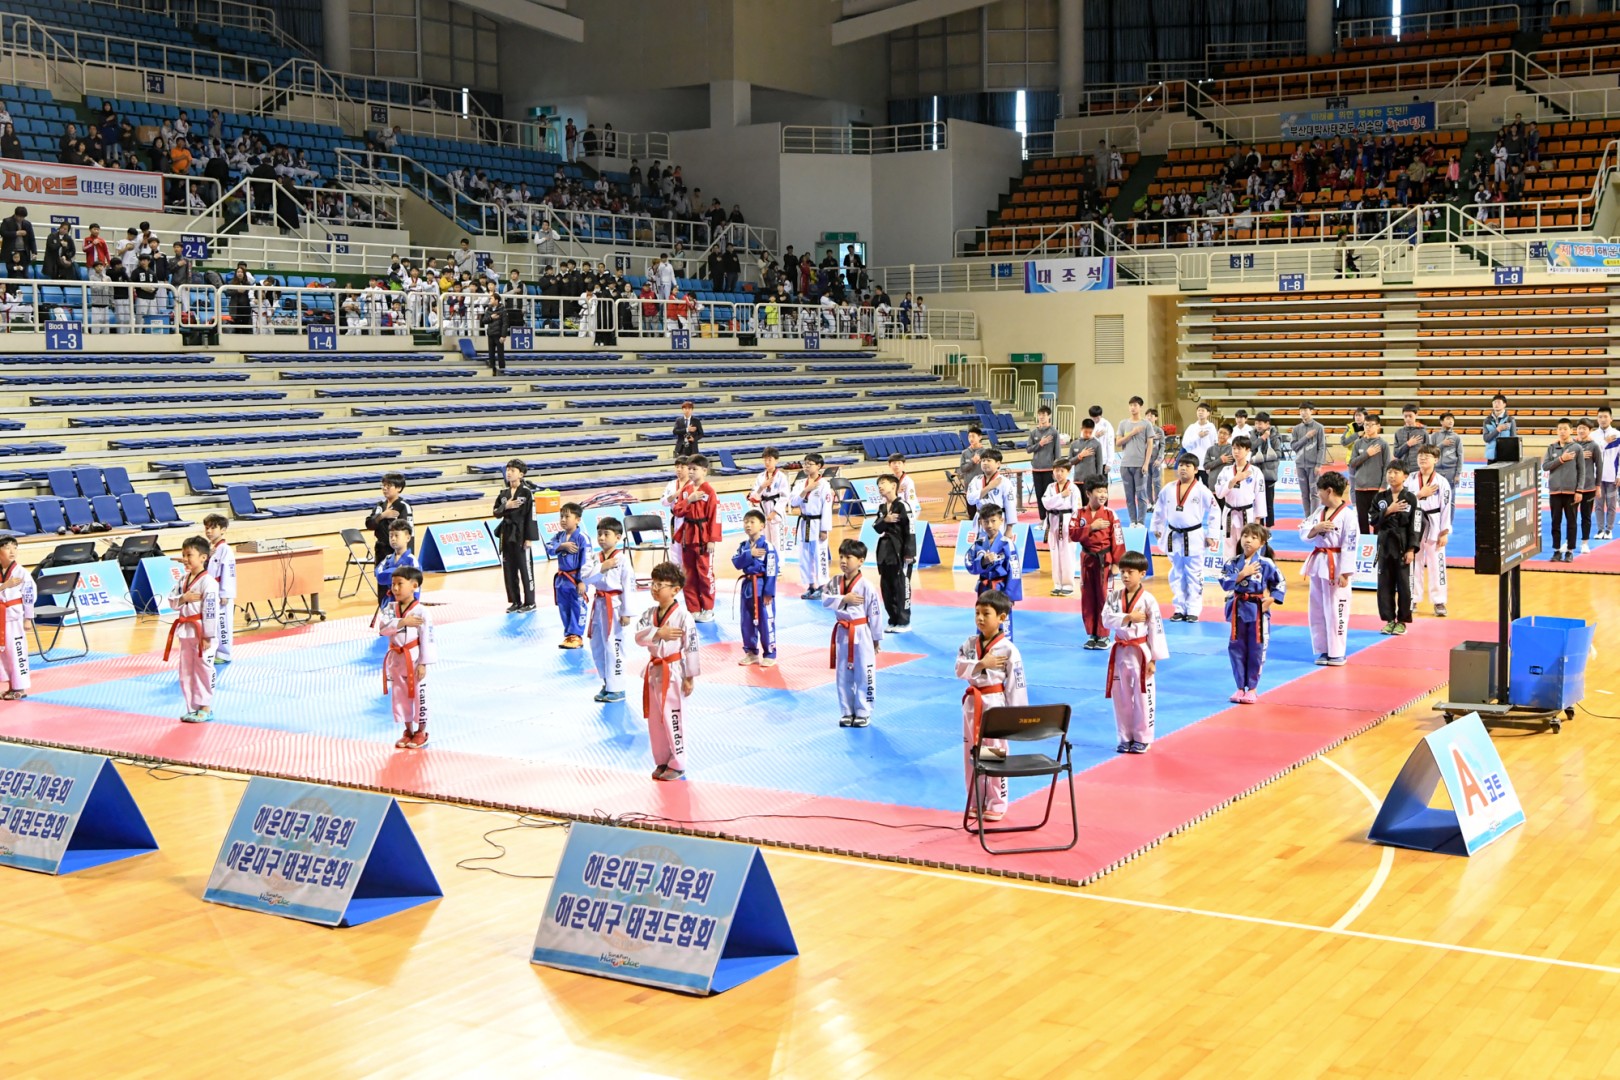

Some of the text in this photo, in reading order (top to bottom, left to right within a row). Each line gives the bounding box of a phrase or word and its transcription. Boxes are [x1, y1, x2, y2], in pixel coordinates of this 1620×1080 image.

[2, 169, 157, 199] 자이언트 대표팀 화이팅!!
[185, 244, 204, 257] 2-4
[1233, 258, 1250, 268] 3-9
[1499, 273, 1518, 283] 1-9
[1283, 281, 1300, 290] 1-8
[52, 333, 77, 349] 1-3
[313, 336, 333, 349] 1-4
[515, 336, 530, 349] 1-5
[674, 338, 688, 349] 1-6
[806, 338, 818, 349] 1-7
[456, 545, 480, 556] 태권도
[1362, 545, 1374, 557] 강
[1204, 556, 1223, 568] 태권
[79, 592, 110, 606] 태권도
[1338, 619, 1345, 630] do
[221, 630, 228, 638] do
[14, 641, 23, 657] can
[18, 657, 27, 668] do
[867, 686, 874, 696] do
[419, 706, 428, 717] do
[671, 713, 679, 732] can
[674, 733, 682, 746] do
[1452, 749, 1505, 816] A 코트
[33, 775, 74, 804] 체육회
[9, 809, 69, 841] 태권도협회
[253, 806, 356, 848] 해운대구 체육회
[226, 842, 354, 890] 해운대구 태권도협회
[584, 854, 714, 903] 해운대구 체육회
[555, 895, 717, 951] 해운대구 태권도협회
